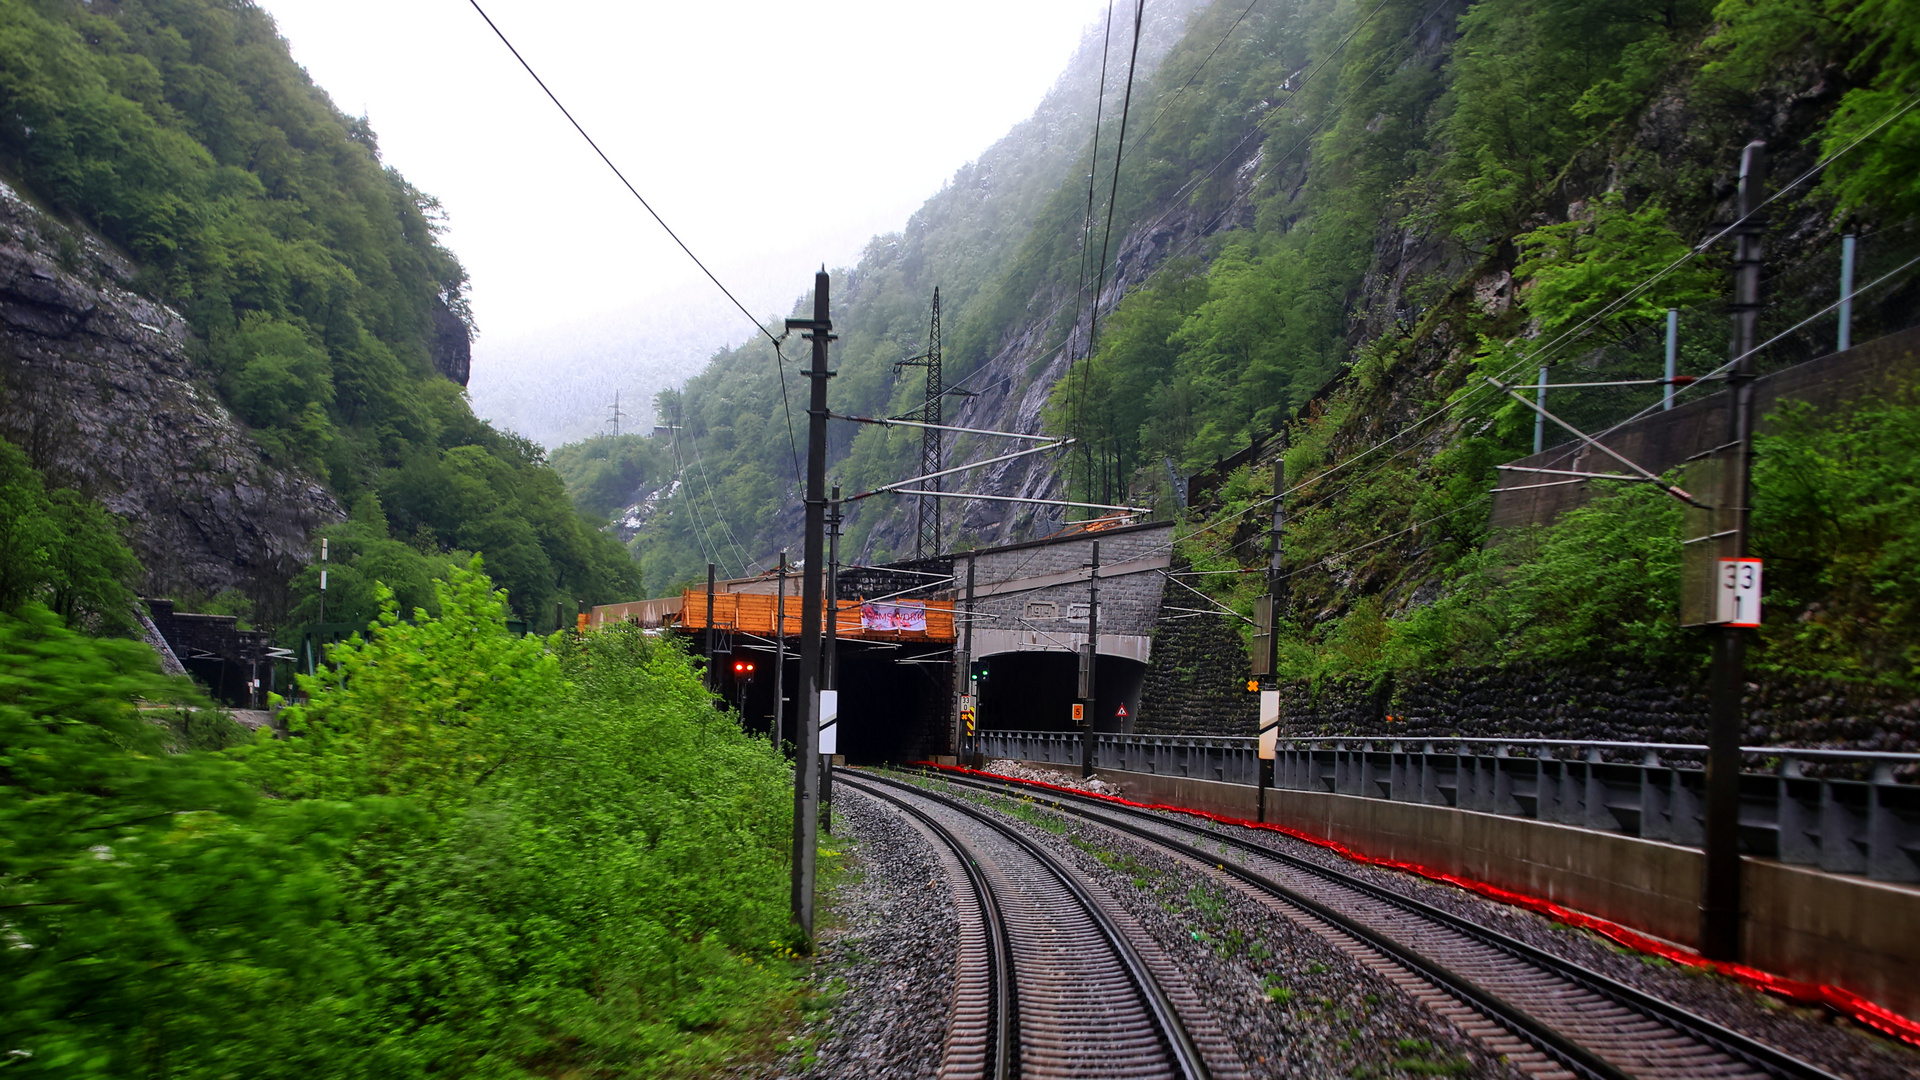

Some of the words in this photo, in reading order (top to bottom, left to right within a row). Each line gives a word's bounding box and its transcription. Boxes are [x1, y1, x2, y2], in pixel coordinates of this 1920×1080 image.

[1723, 564, 1753, 589] 33
[1031, 606, 1052, 617] 1914
[1735, 596, 1742, 619] 1
[1075, 708, 1081, 716] 5
